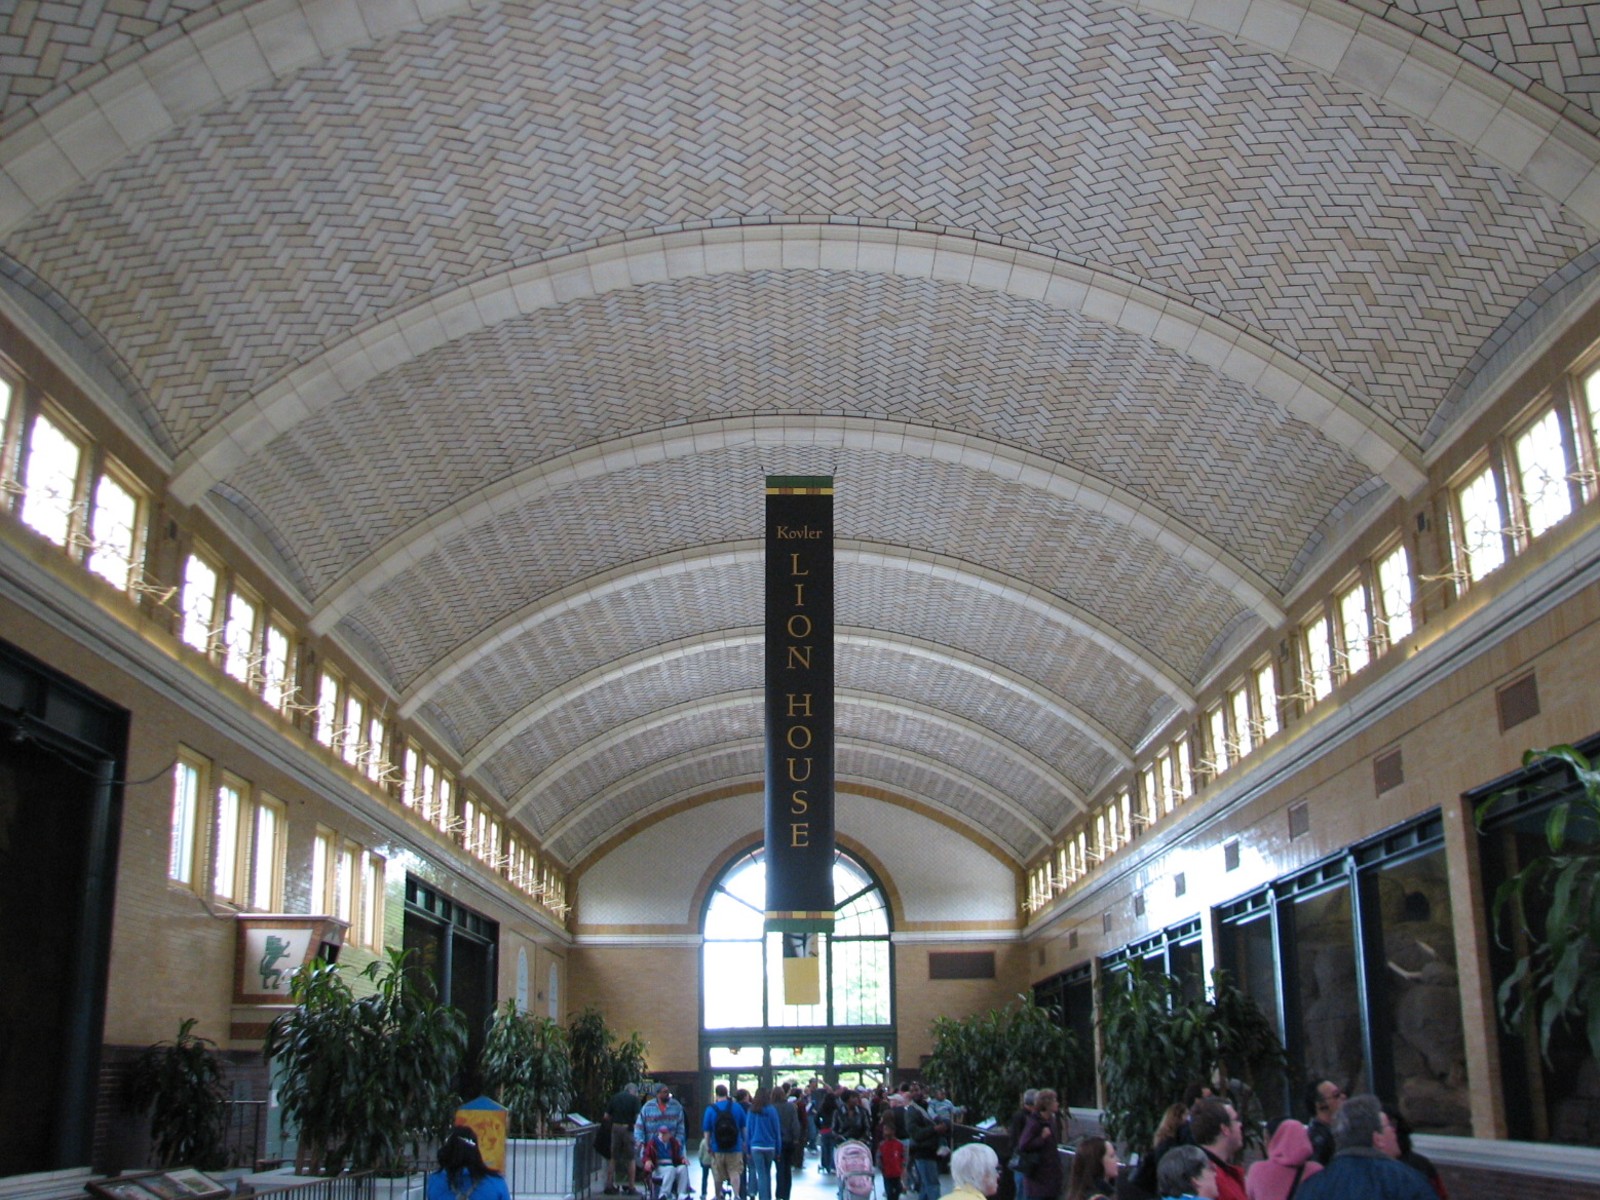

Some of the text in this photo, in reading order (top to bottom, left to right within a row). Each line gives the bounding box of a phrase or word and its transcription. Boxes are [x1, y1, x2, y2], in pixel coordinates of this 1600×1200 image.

[776, 525, 823, 540] Kovler
[786, 553, 813, 848] LION HOUSE
